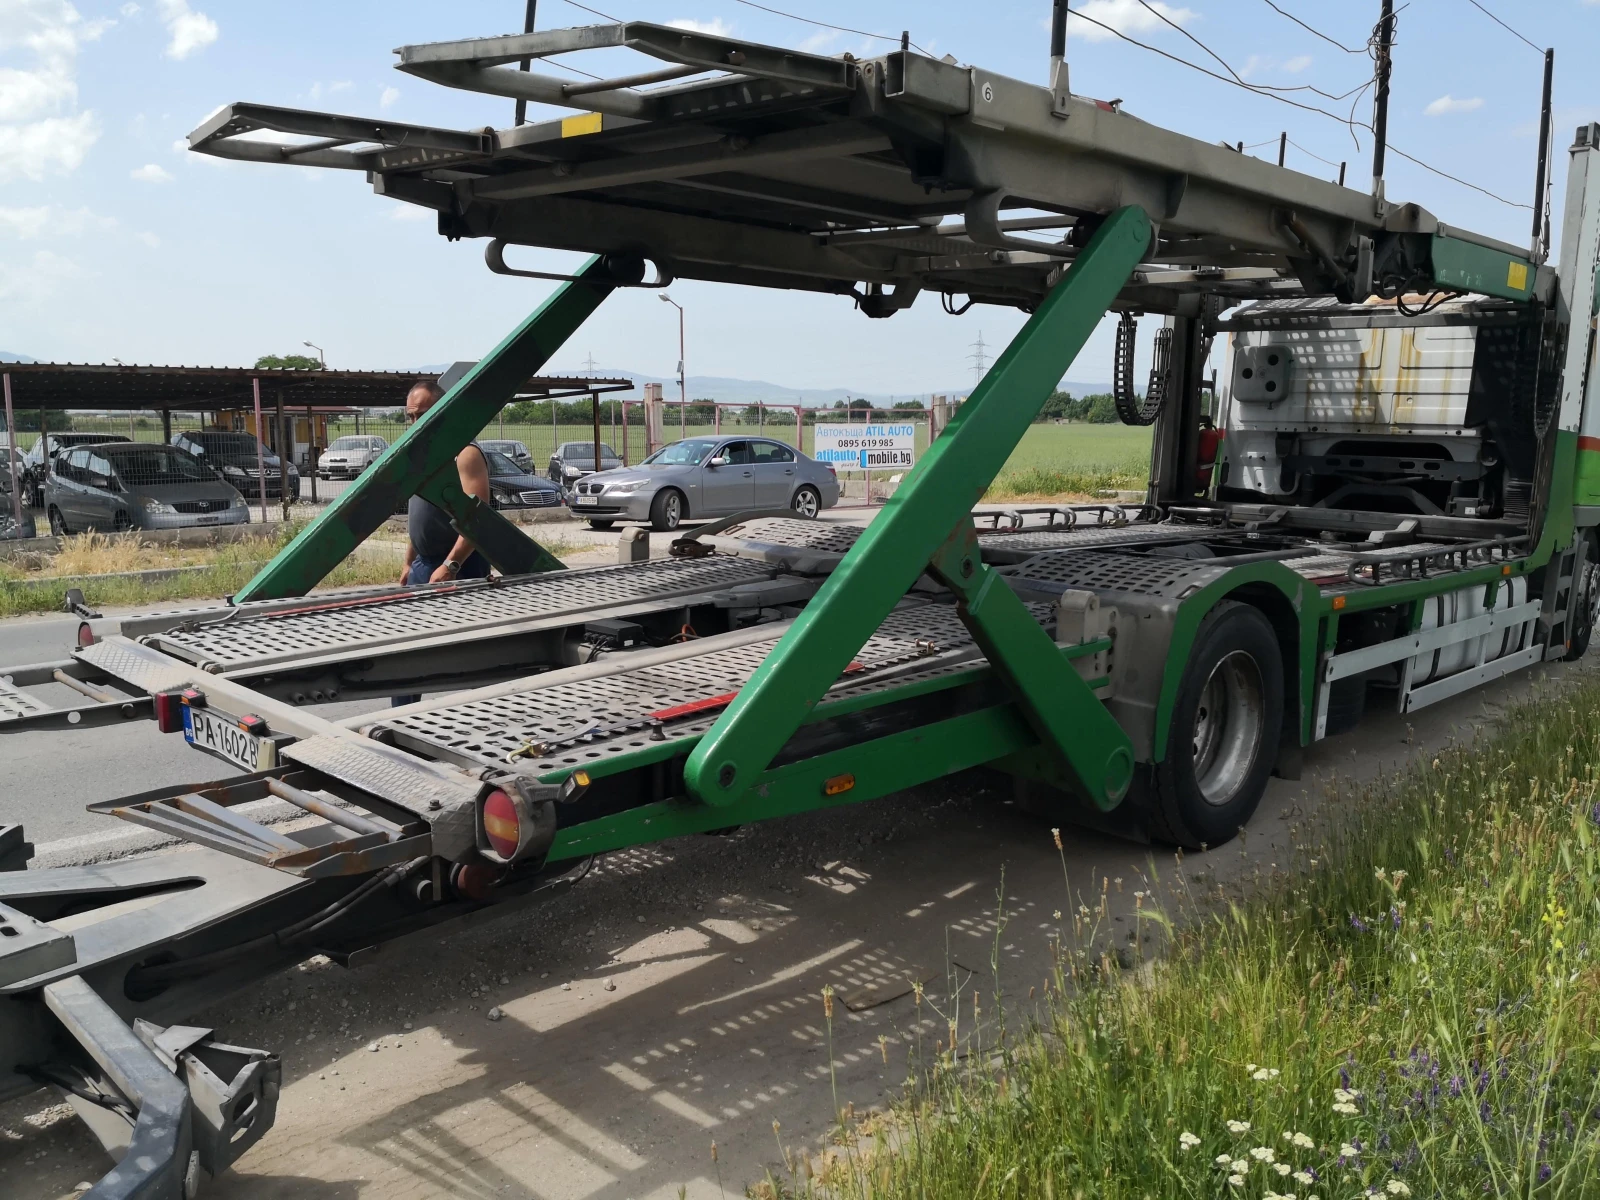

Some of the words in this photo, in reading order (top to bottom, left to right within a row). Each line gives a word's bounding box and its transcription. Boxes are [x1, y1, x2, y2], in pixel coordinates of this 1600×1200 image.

[984, 86, 992, 101] 6
[816, 426, 863, 438] Автокъща
[865, 425, 885, 436] ATIL
[888, 425, 914, 436] AUTO
[838, 439, 859, 448] 0895
[861, 439, 877, 447] 619
[878, 438, 894, 447] 985
